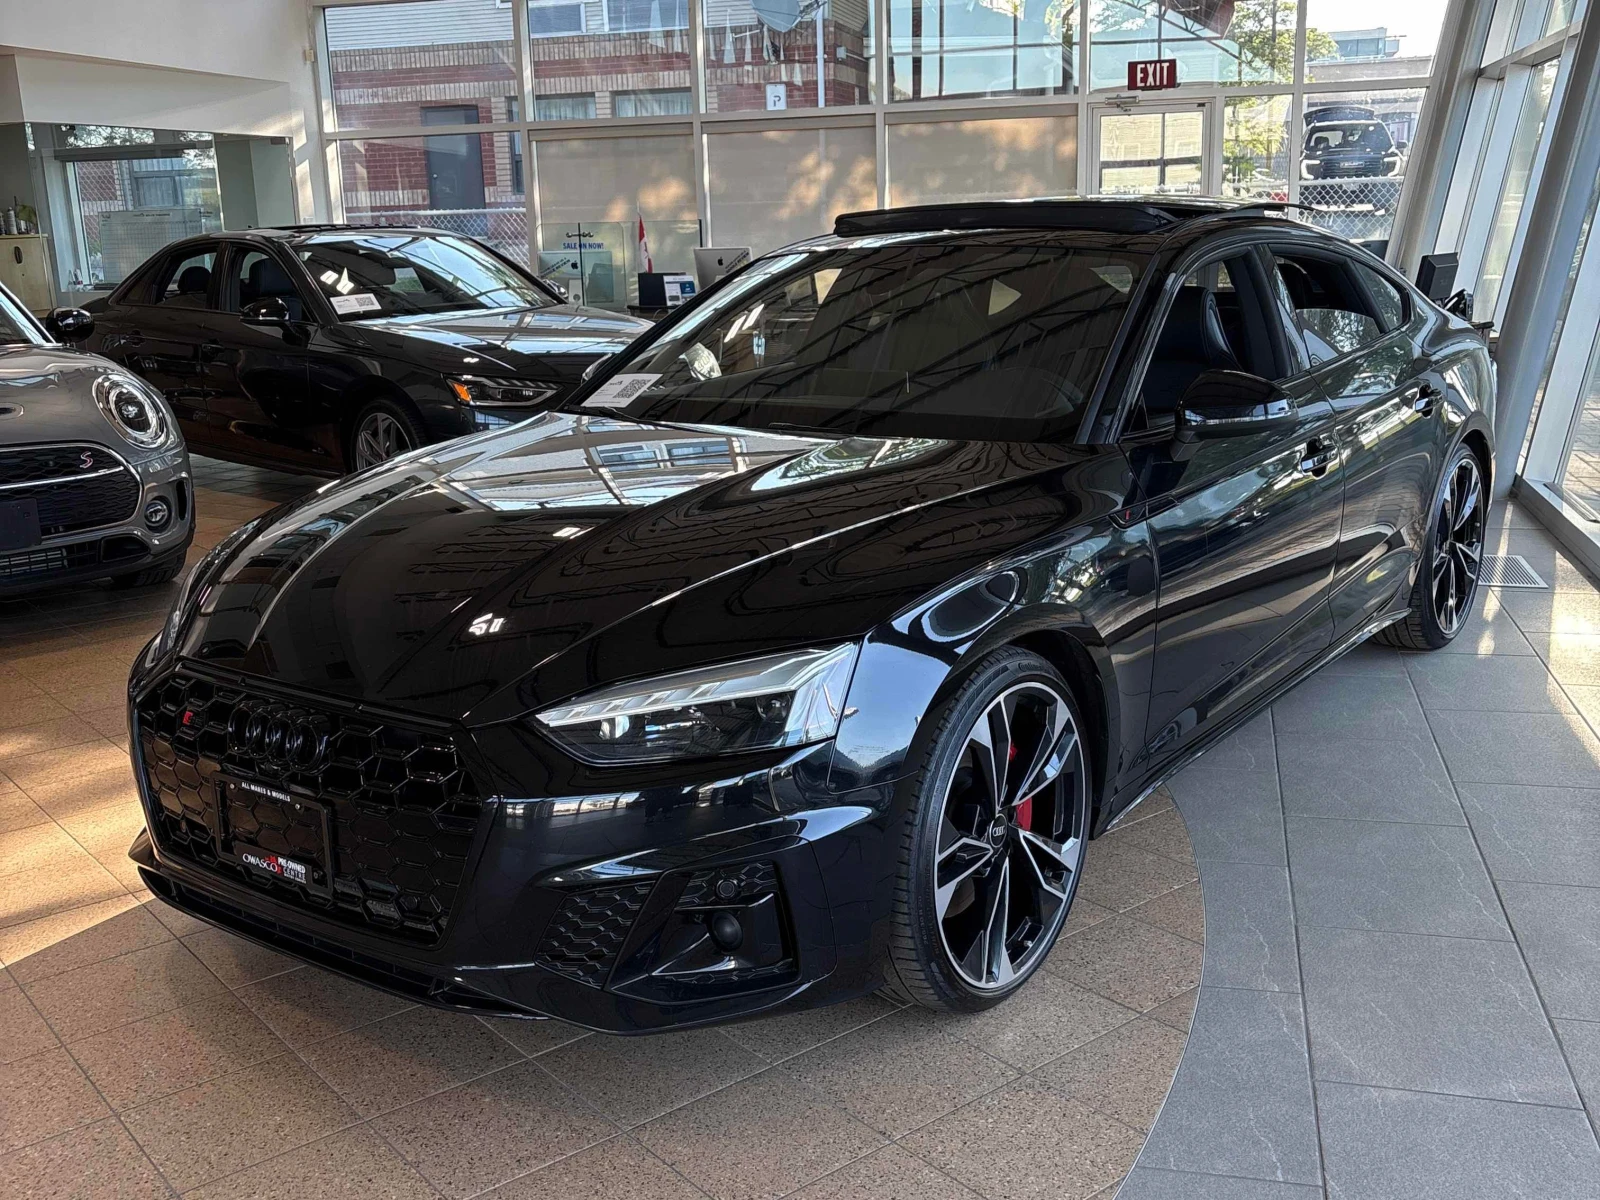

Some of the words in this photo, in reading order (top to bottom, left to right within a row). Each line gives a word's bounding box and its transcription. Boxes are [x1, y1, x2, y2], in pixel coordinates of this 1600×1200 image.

[1136, 62, 1170, 87] EXIT
[563, 242, 578, 250] SALE
[578, 242, 587, 250] ON
[588, 242, 604, 250] NOW!
[80, 451, 93, 469] S
[241, 781, 250, 790] ALL
[250, 783, 267, 795] MAKES
[271, 790, 291, 802] MODELS
[243, 853, 277, 872] OWASCO
[277, 856, 306, 874] PRE-OWNED
[283, 866, 306, 880] CENTRE
